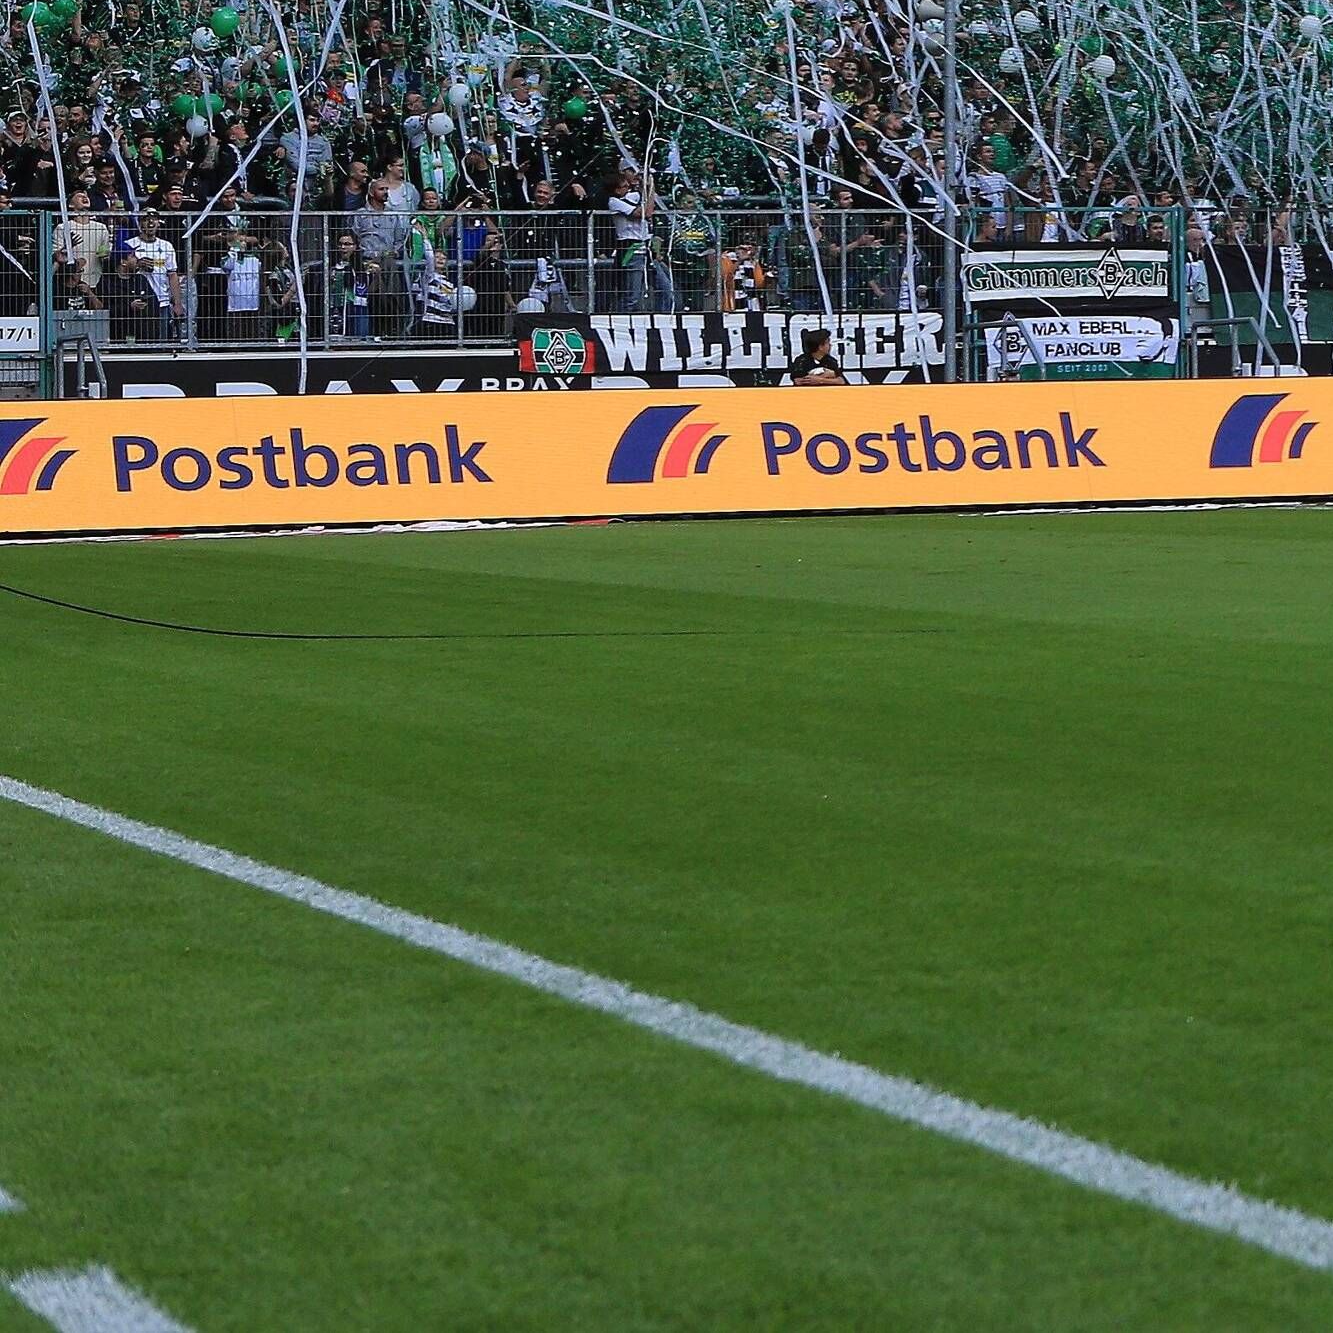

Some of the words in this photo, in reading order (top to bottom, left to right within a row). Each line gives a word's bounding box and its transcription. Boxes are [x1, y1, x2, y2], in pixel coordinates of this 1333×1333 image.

[1032, 321, 1071, 336] MAX
[1079, 320, 1133, 335] EBERL
[1044, 342, 1122, 358] FANCLUB
[1056, 364, 1081, 374] SEIT
[761, 411, 1107, 476] Postbank
[112, 424, 494, 493] Postbank
